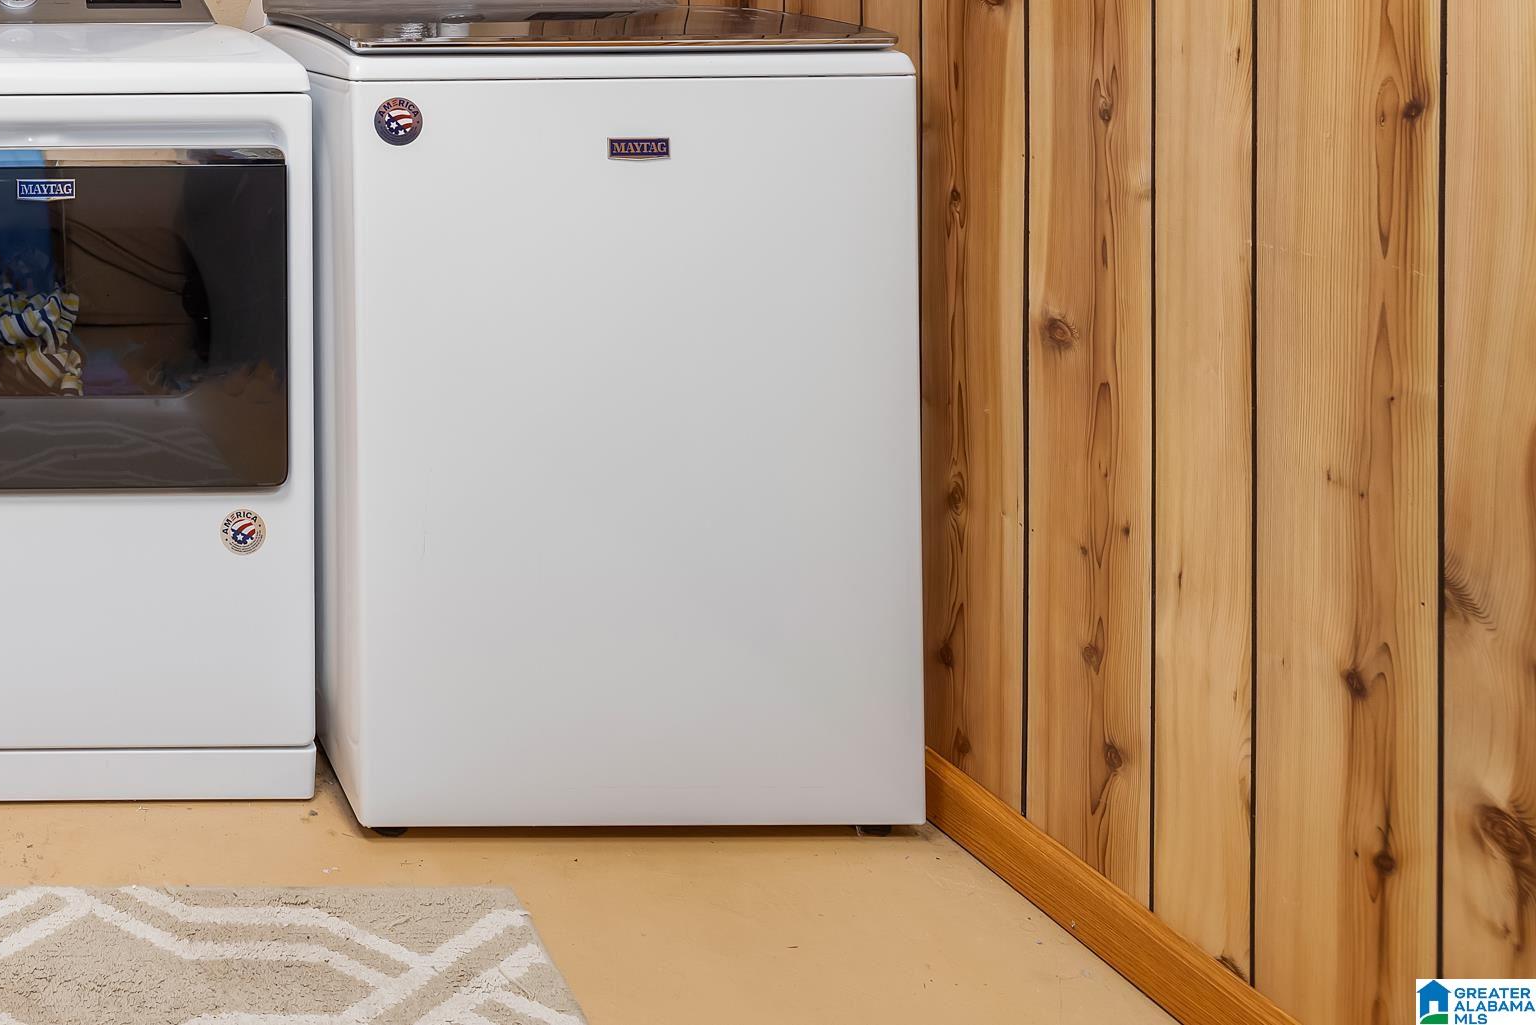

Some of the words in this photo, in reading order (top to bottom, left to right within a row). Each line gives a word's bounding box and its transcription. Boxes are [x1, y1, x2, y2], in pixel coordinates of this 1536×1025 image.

[378, 99, 419, 117] AMERICA
[612, 142, 667, 153] MAYTAG
[20, 183, 72, 195] MAYTAG
[222, 511, 258, 535] AMERICA
